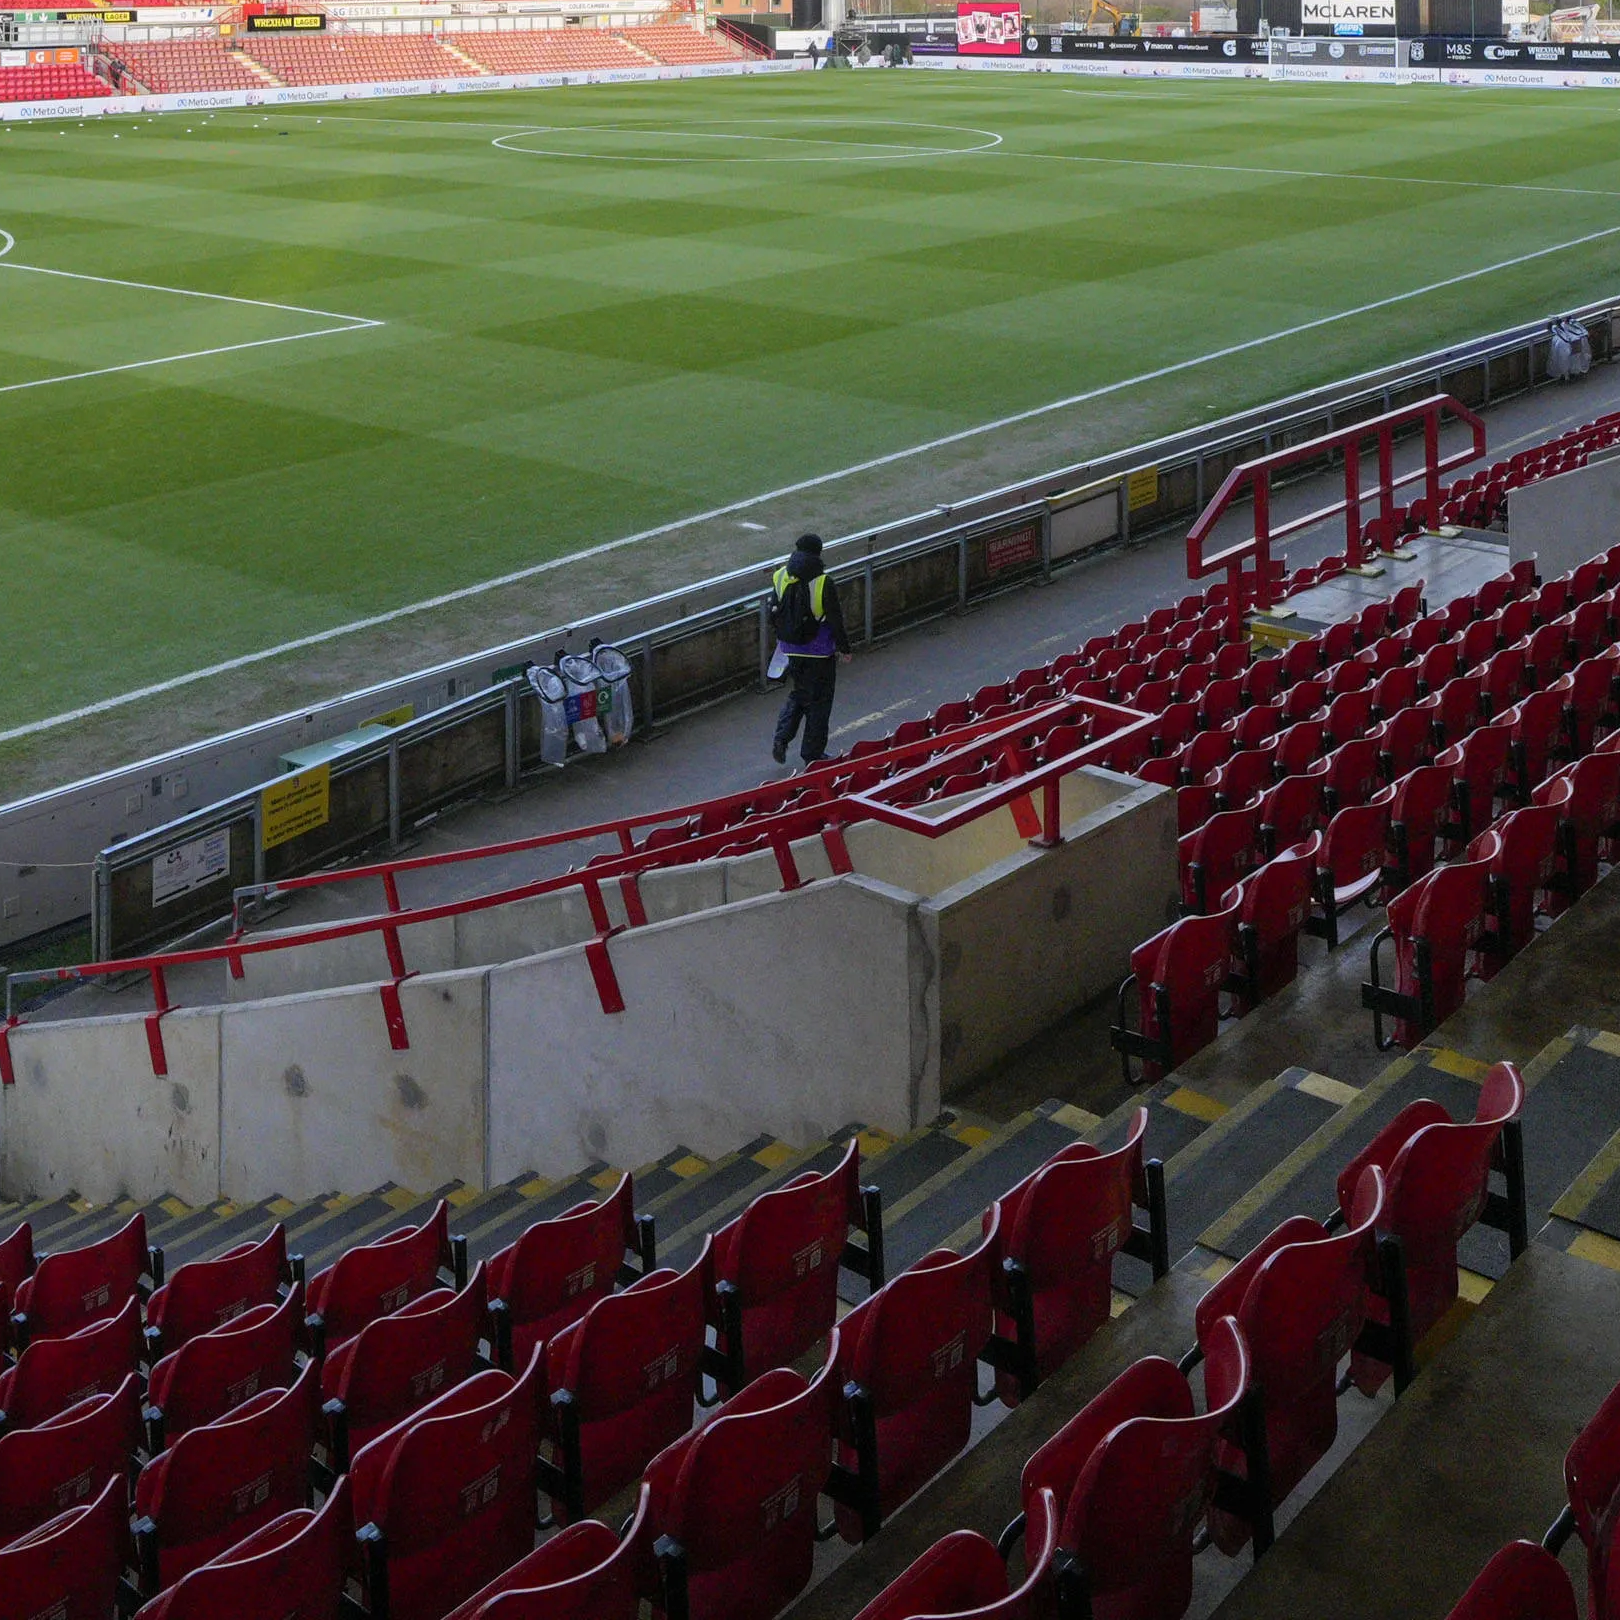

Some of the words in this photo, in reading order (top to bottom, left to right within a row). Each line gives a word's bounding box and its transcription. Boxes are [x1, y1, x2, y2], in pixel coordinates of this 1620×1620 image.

[349, 7, 386, 16] ESTATES
[105, 12, 130, 21] LAGER
[253, 18, 292, 28] WREXHAM
[295, 17, 321, 27] LAGER
[1446, 44, 1472, 55] M&S
[1527, 46, 1565, 56] WREXHAM
[35, 51, 45, 63] G
[925, 60, 944, 68] Quest
[1007, 62, 1026, 70] Quest
[1071, 64, 1089, 72] Meta
[1088, 64, 1108, 72] Quest
[1191, 67, 1210, 75] Meta
[1210, 67, 1233, 76] Quest
[1286, 69, 1305, 77] Meta
[1305, 69, 1329, 78] Quest
[1411, 72, 1435, 81] Quest
[1495, 75, 1517, 83] Meta
[1518, 74, 1544, 84] Quest
[482, 81, 500, 89] Quest
[382, 87, 402, 95] Meta
[402, 85, 420, 95] Quest
[287, 93, 308, 101] Meta
[308, 91, 329, 101] Quest
[188, 98, 209, 107] Meta
[209, 96, 233, 106] Quest
[32, 107, 57, 116] Meta
[57, 105, 84, 115] Quest
